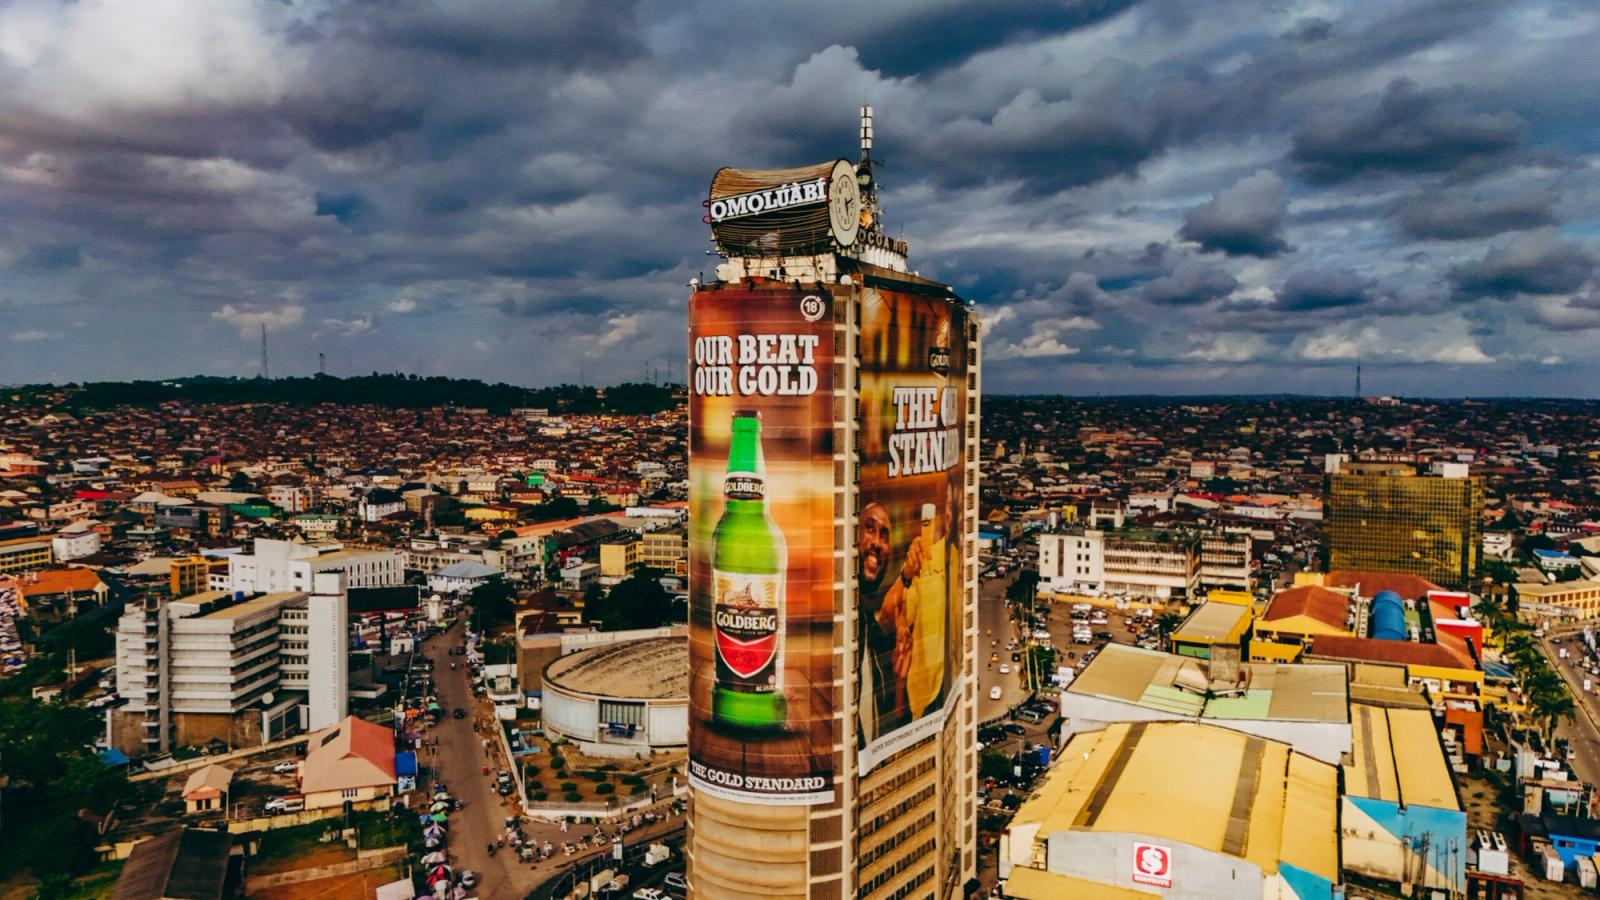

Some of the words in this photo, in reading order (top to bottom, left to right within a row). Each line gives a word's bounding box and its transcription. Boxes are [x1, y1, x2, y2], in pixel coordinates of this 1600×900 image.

[695, 335, 734, 366] OUR
[738, 334, 819, 365] BEAT
[695, 366, 734, 396] OUR
[738, 365, 818, 396] GOLD
[893, 387, 938, 430] THE
[717, 611, 776, 630] GOLDBERG
[691, 760, 707, 778] THE
[707, 769, 743, 787] GOLD
[745, 776, 825, 791] STANDARD
